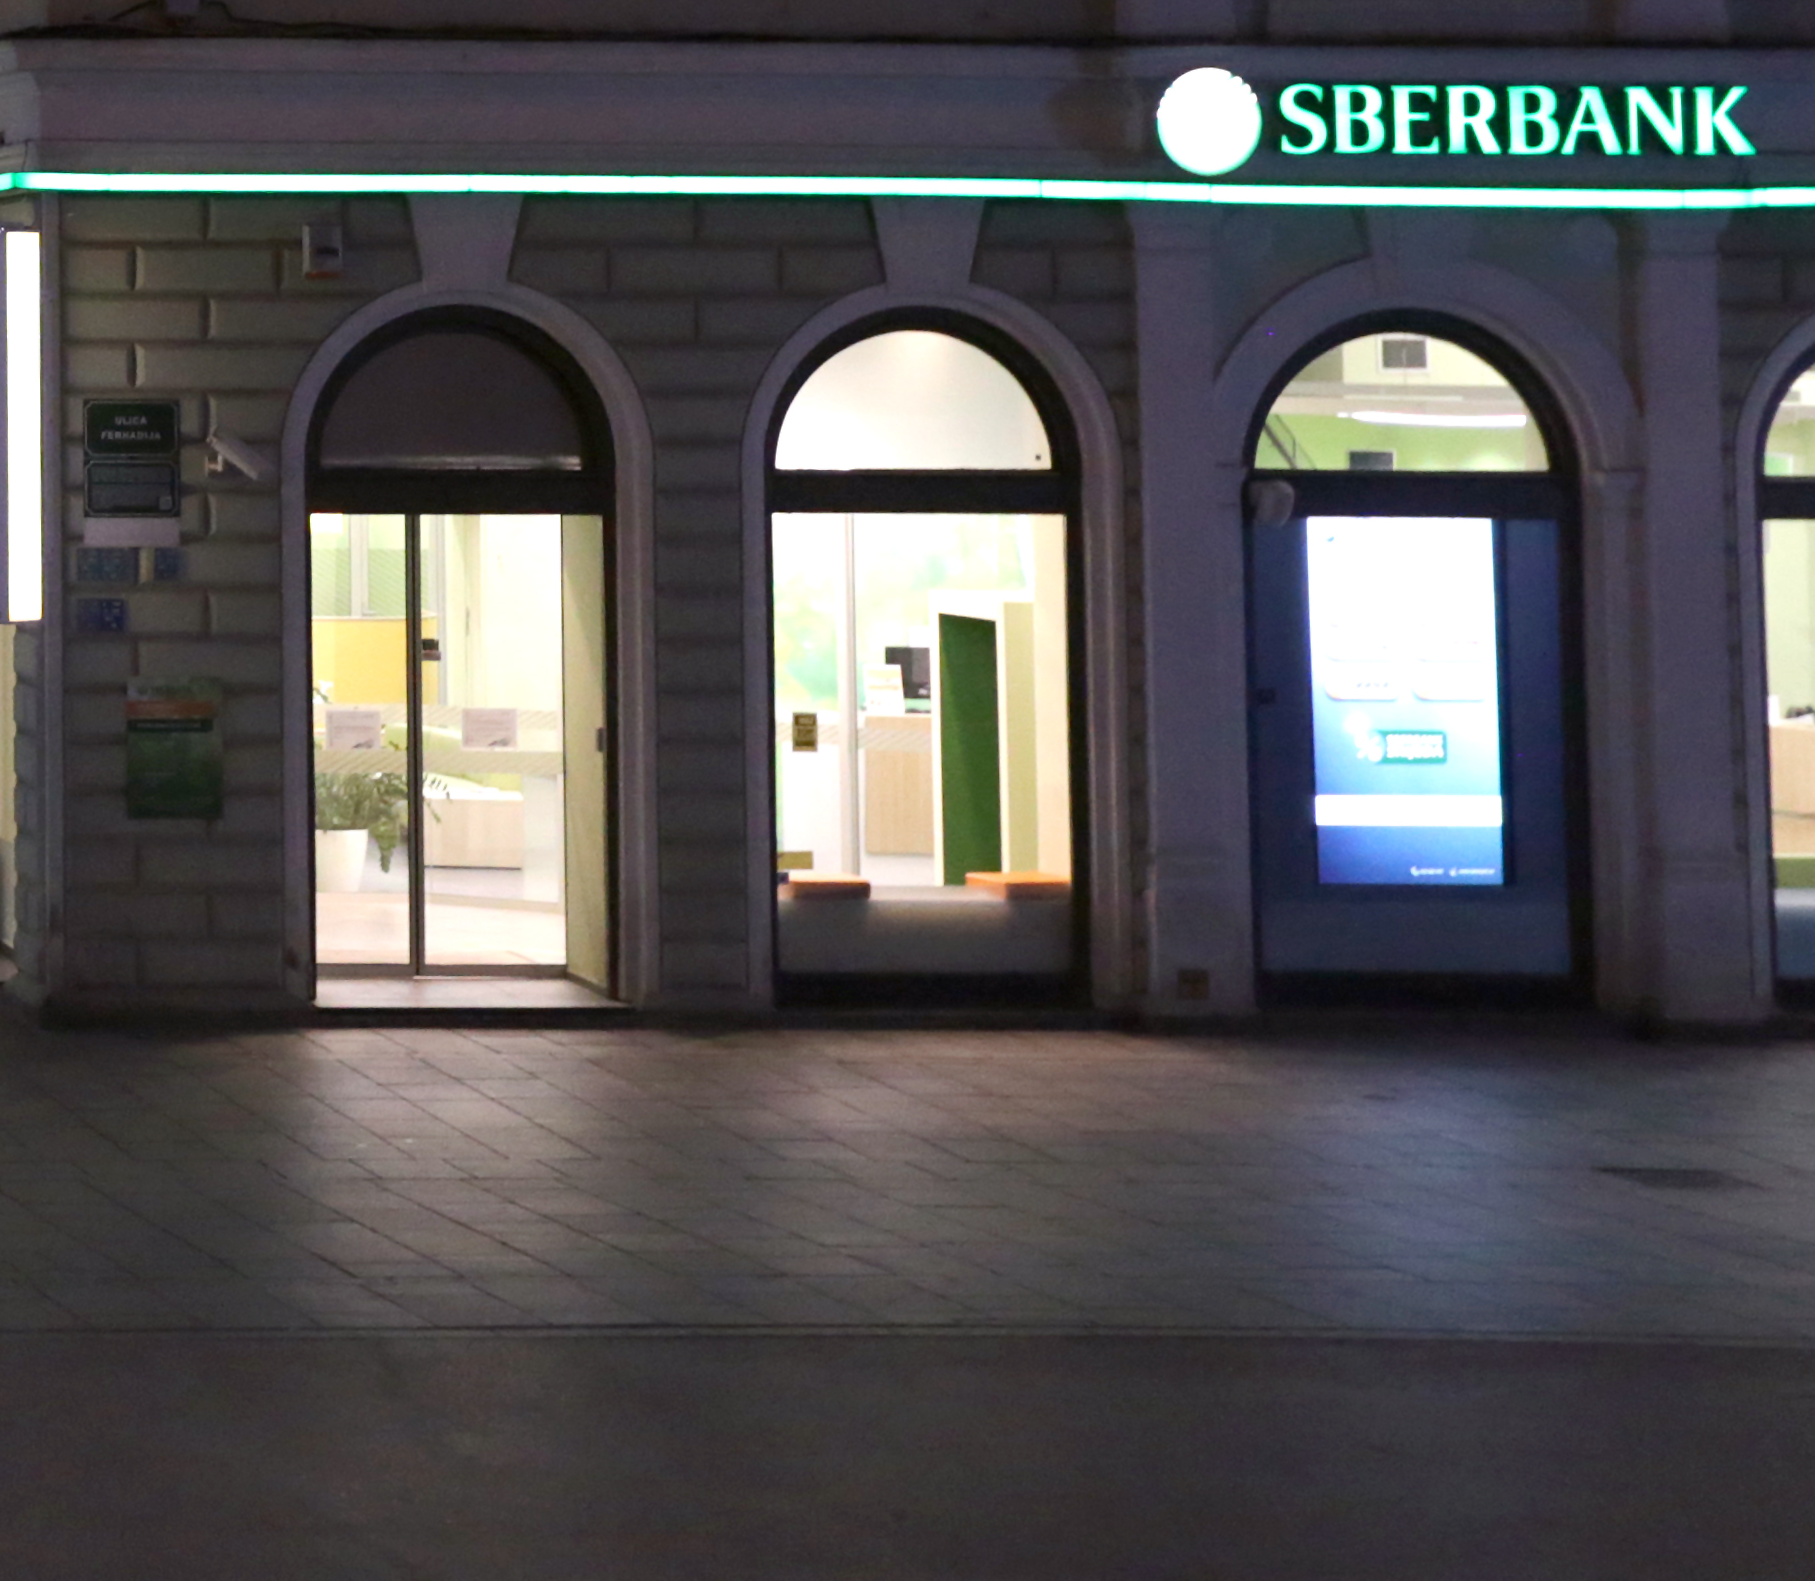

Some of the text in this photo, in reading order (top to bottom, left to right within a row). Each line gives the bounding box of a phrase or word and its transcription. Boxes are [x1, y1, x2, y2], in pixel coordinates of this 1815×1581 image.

[1278, 82, 1756, 157] SBERBANK
[114, 415, 148, 425] ULICA
[100, 430, 162, 441] FERHADIJA
